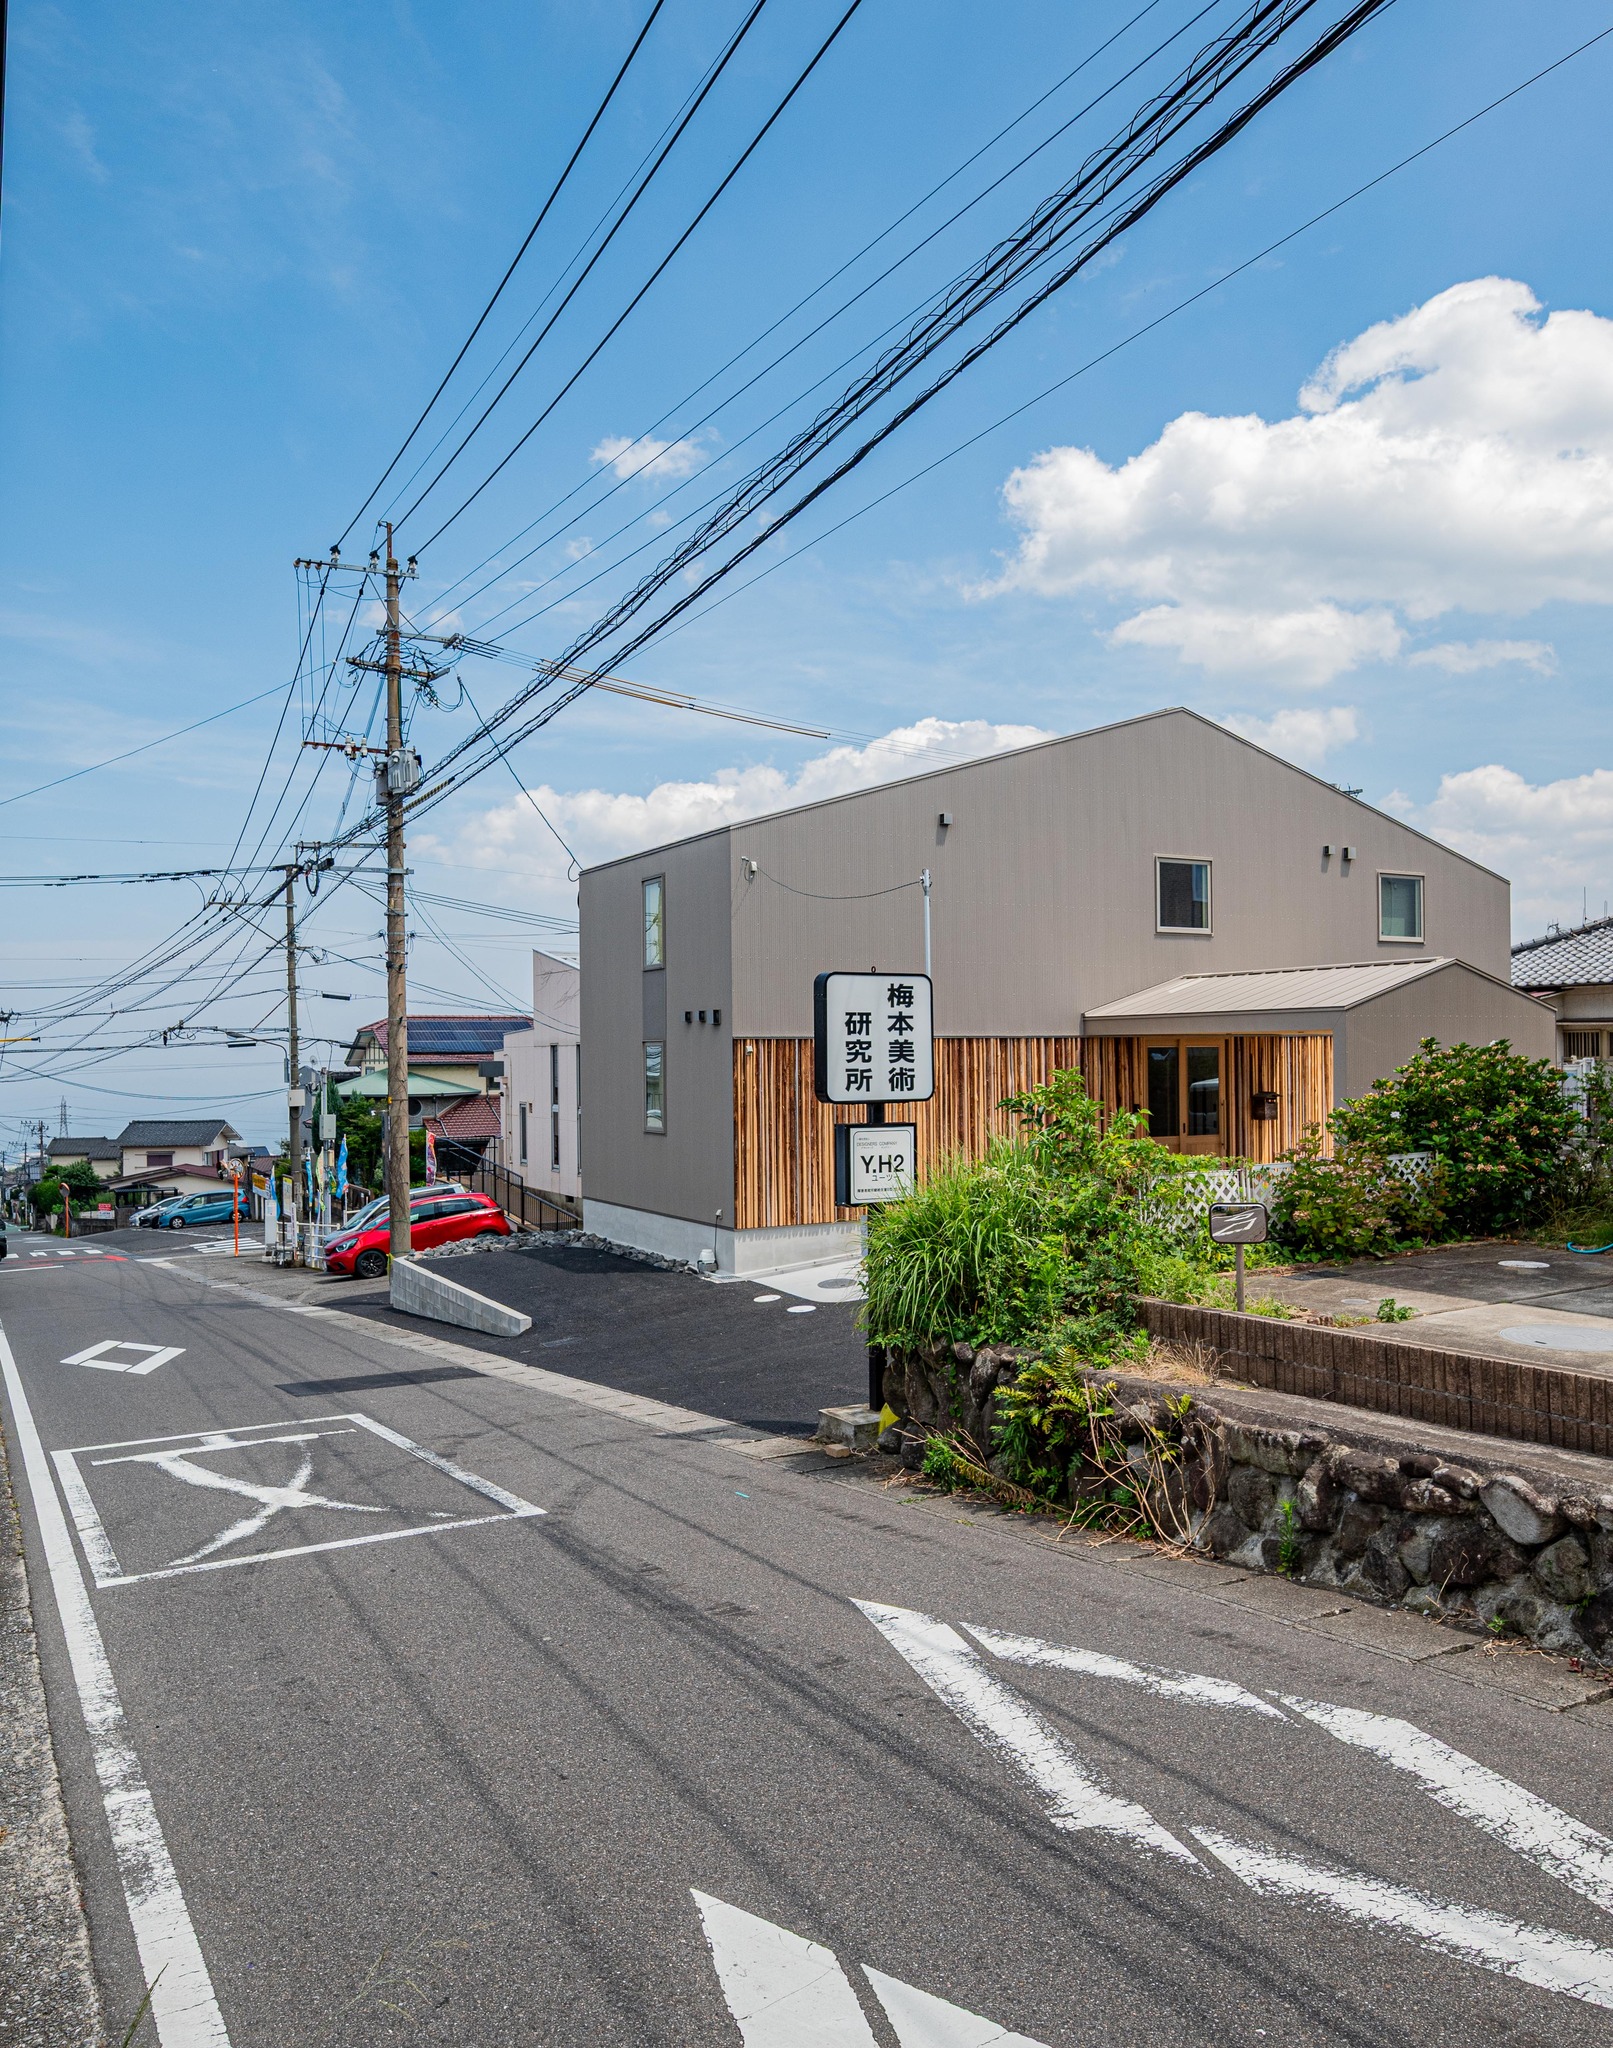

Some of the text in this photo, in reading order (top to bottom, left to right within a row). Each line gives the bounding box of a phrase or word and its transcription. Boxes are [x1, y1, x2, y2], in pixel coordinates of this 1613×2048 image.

[844, 1011, 873, 1092] 研究所
[887, 983, 916, 1092] 梅本美術
[860, 1154, 905, 1174] Y.H2
